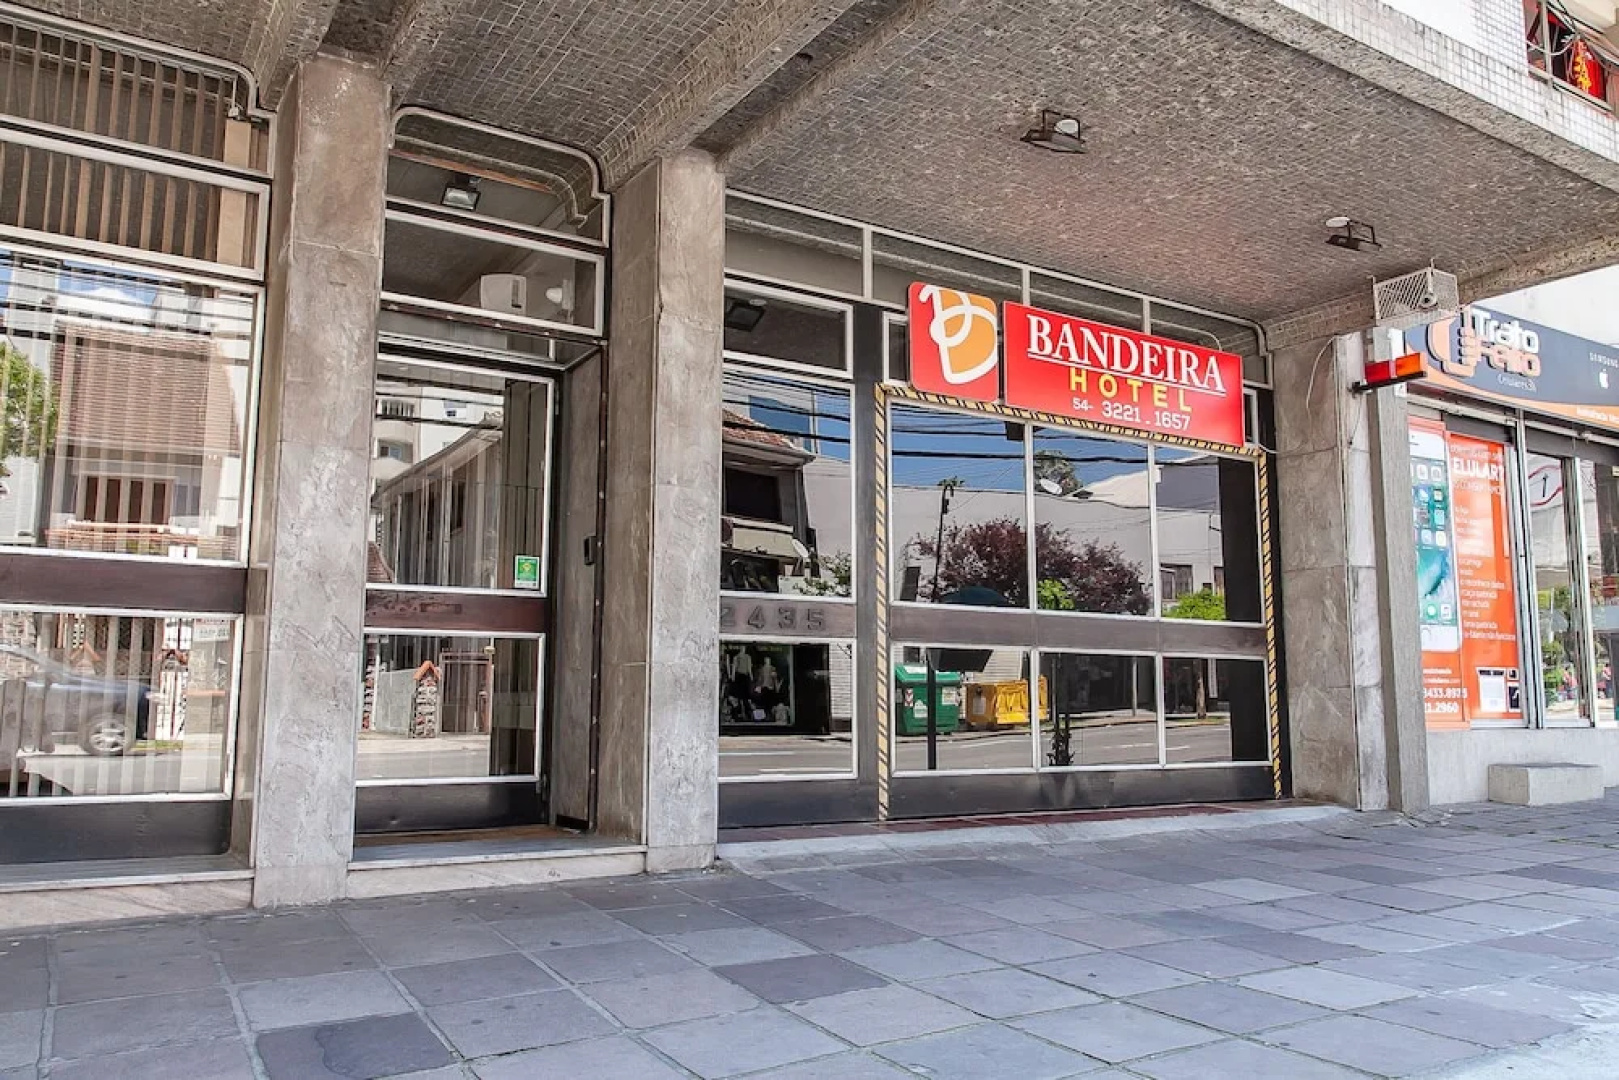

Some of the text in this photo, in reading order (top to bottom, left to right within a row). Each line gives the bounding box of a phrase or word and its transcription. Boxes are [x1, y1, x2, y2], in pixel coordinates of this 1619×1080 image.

[1026, 314, 1226, 393] BANDEIRA
[1069, 366, 1192, 413] HOTEL
[721, 603, 827, 631] 2435
